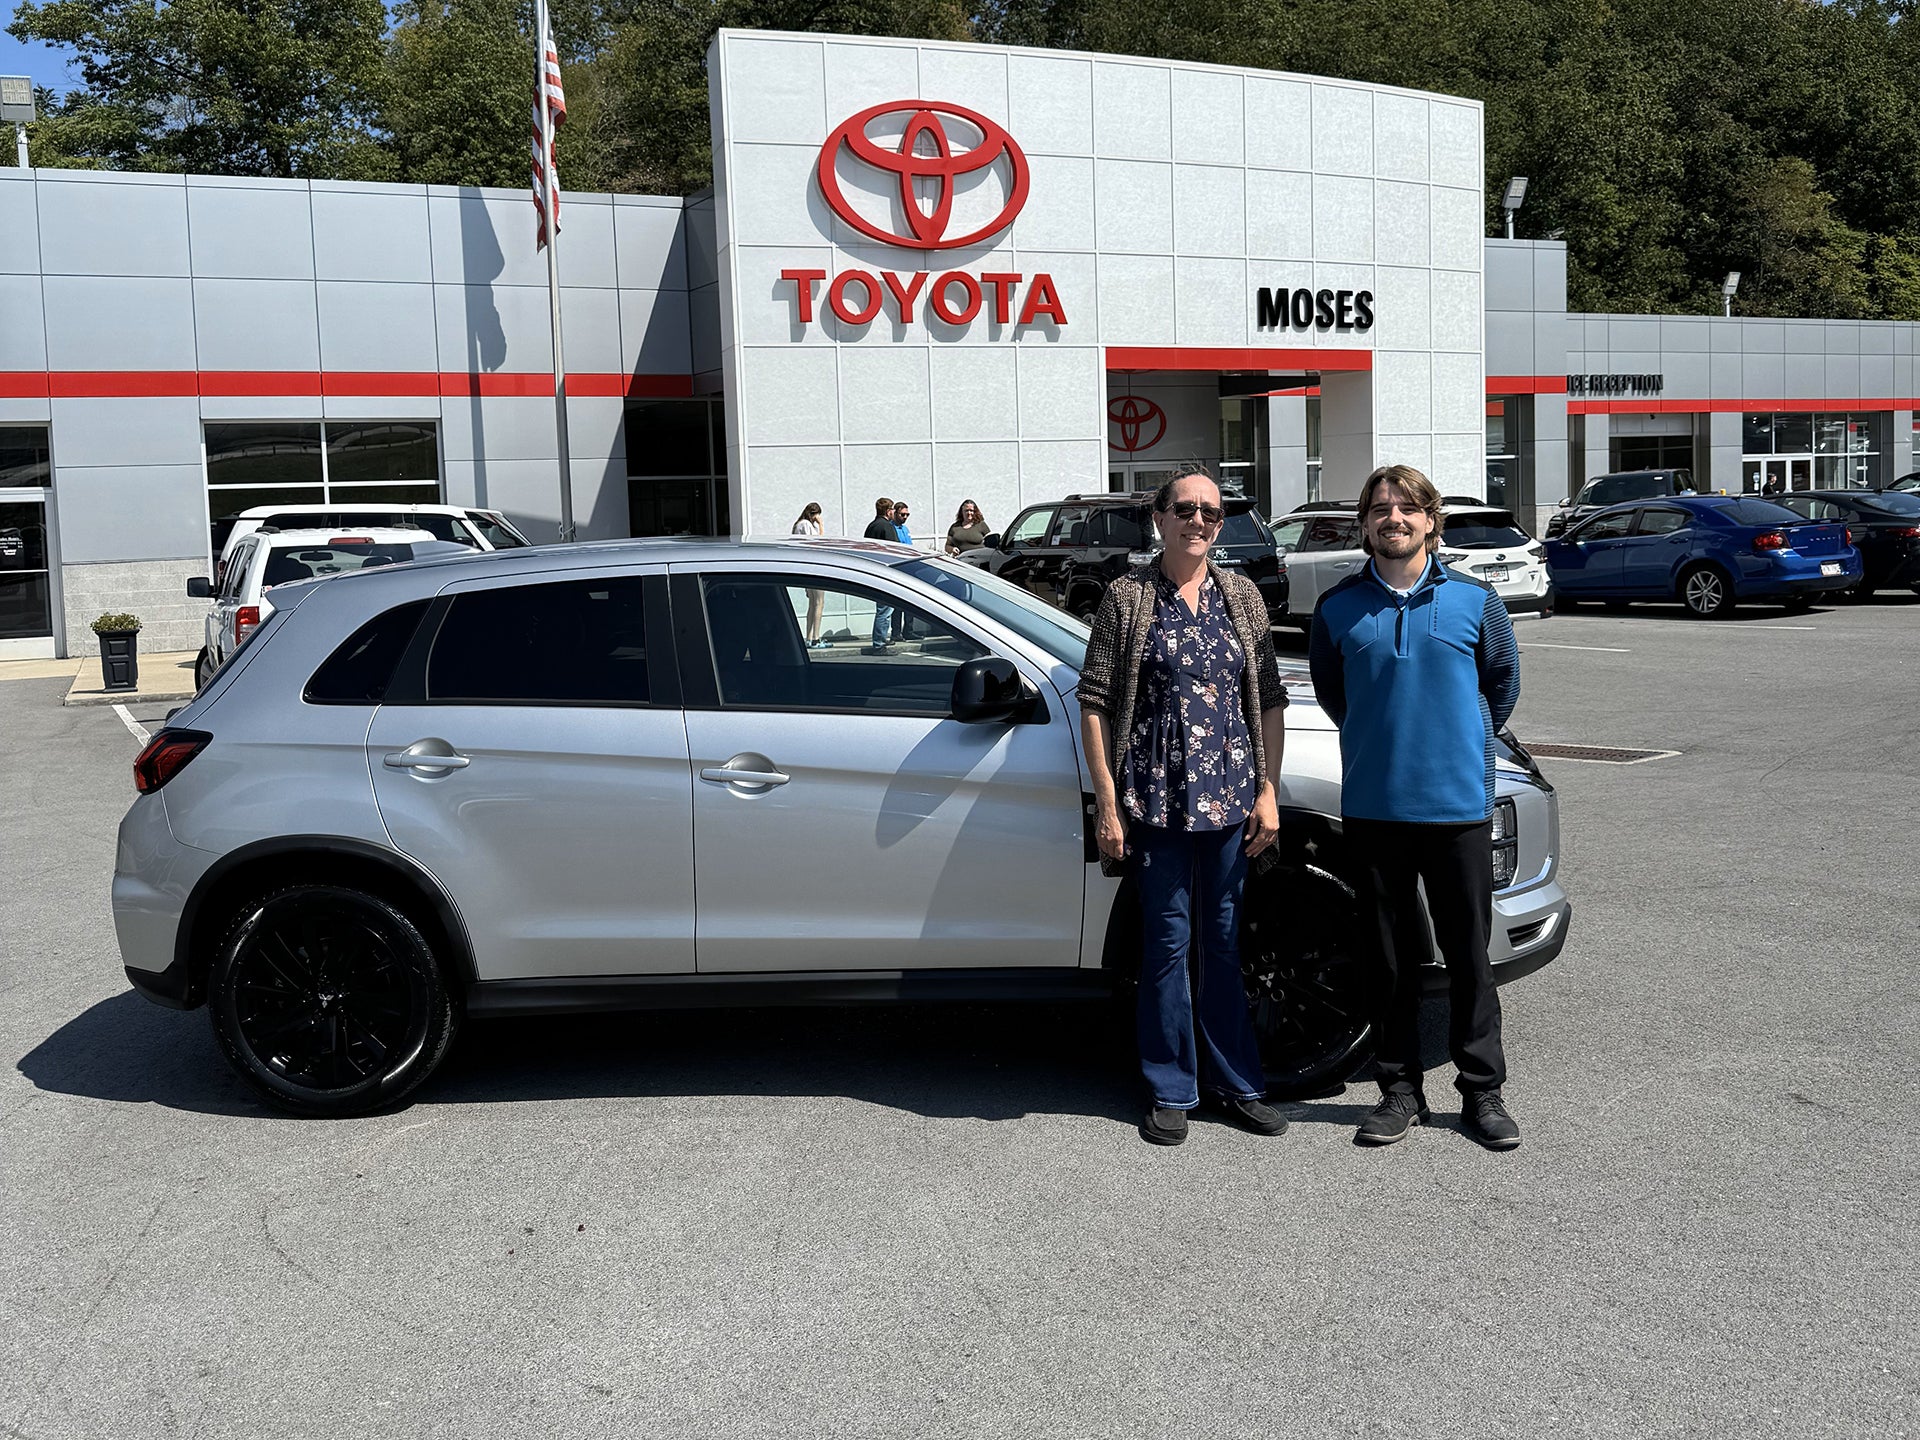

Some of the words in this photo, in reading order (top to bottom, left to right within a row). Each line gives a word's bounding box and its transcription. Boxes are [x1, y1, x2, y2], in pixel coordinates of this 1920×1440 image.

[781, 269, 1068, 325] TOYOTA
[1257, 287, 1374, 329] MOSES
[1589, 374, 1663, 391] RECEPTION
